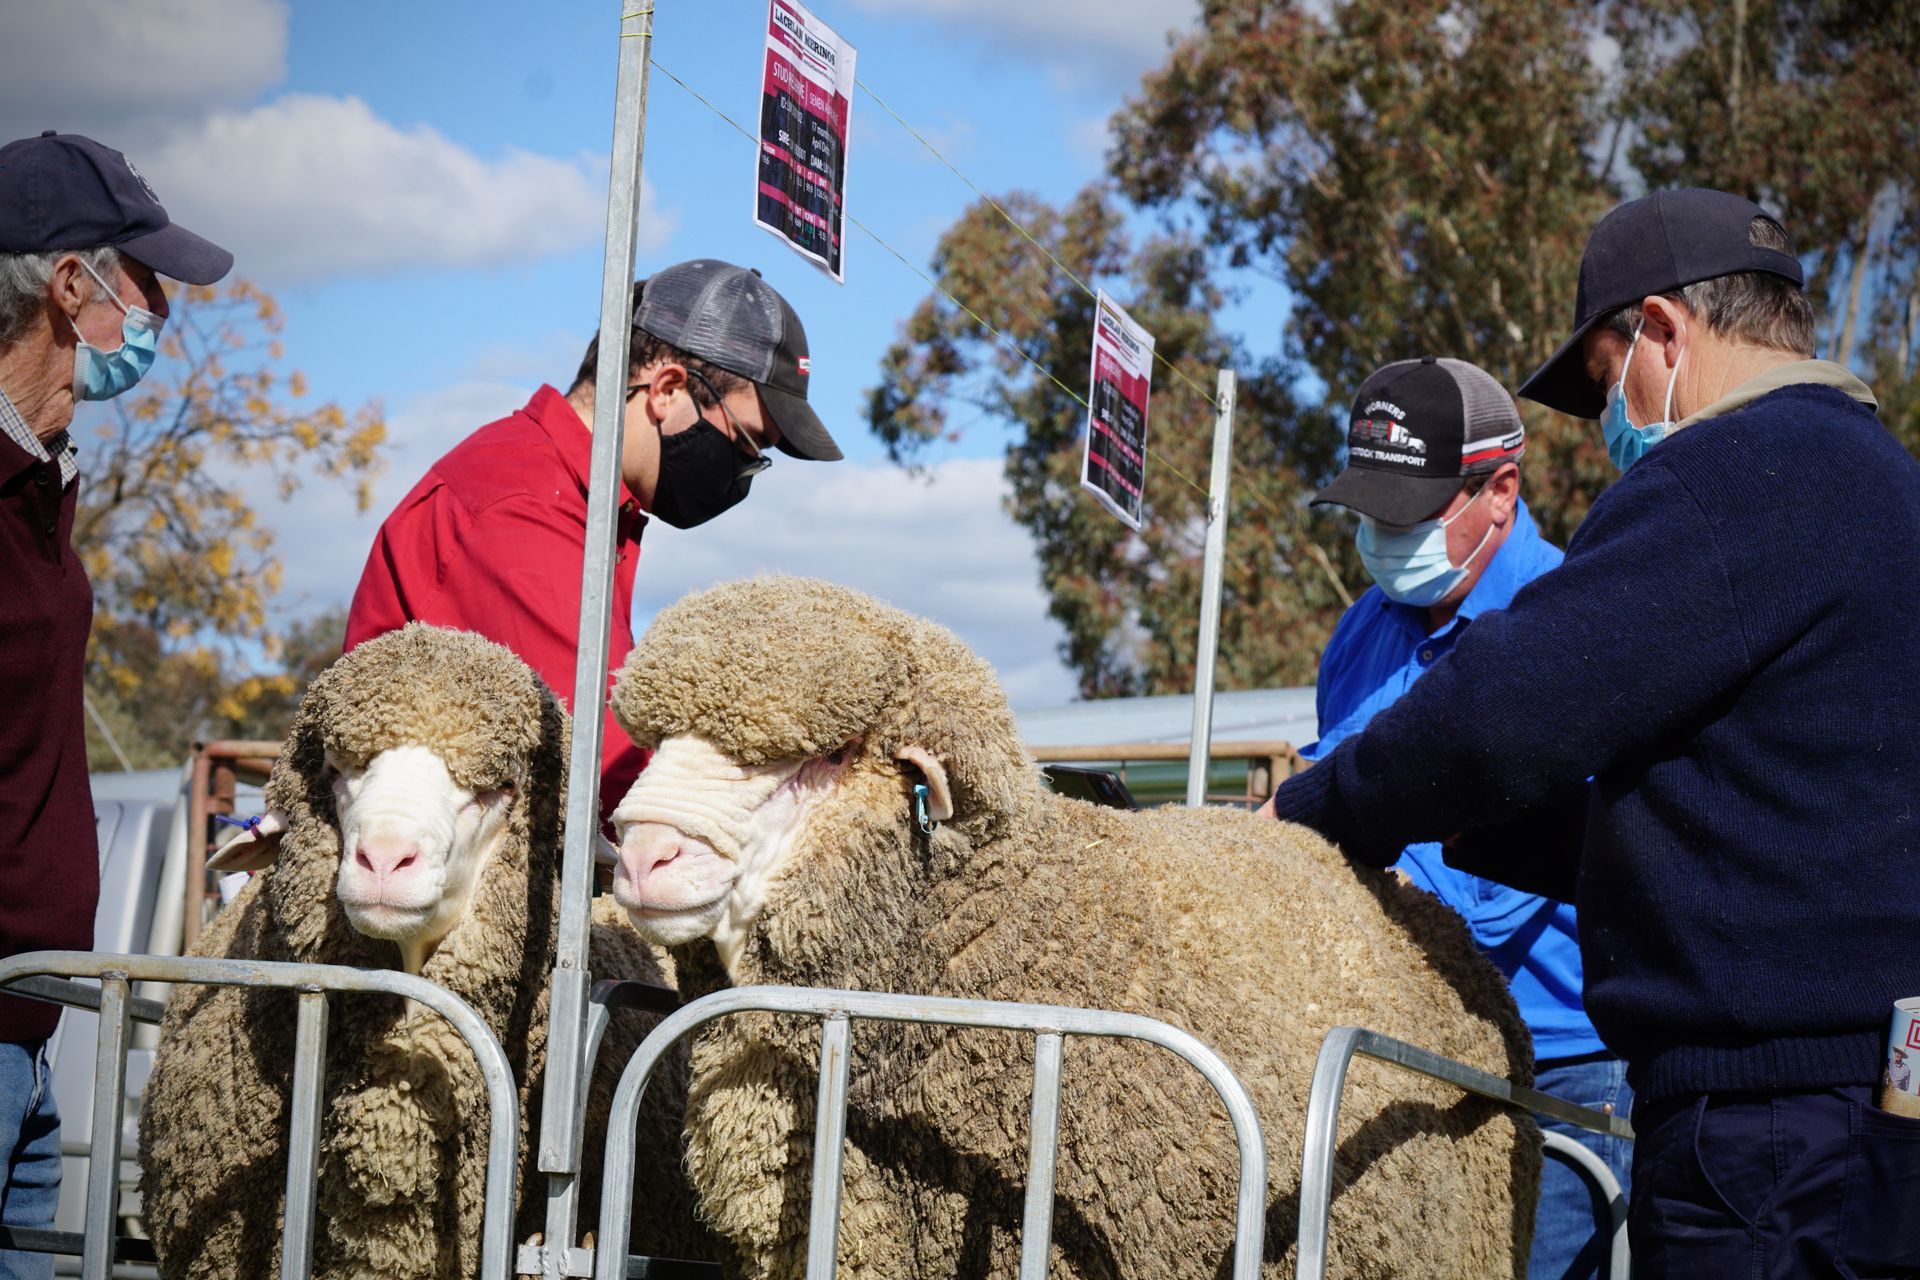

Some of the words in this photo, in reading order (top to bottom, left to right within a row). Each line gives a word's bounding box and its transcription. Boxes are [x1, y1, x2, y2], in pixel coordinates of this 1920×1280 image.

[775, 7, 804, 41] LACHLAN
[804, 33, 836, 67] MERINOS
[773, 61, 789, 83] STUD
[1375, 450, 1427, 467] TRANSPORT
